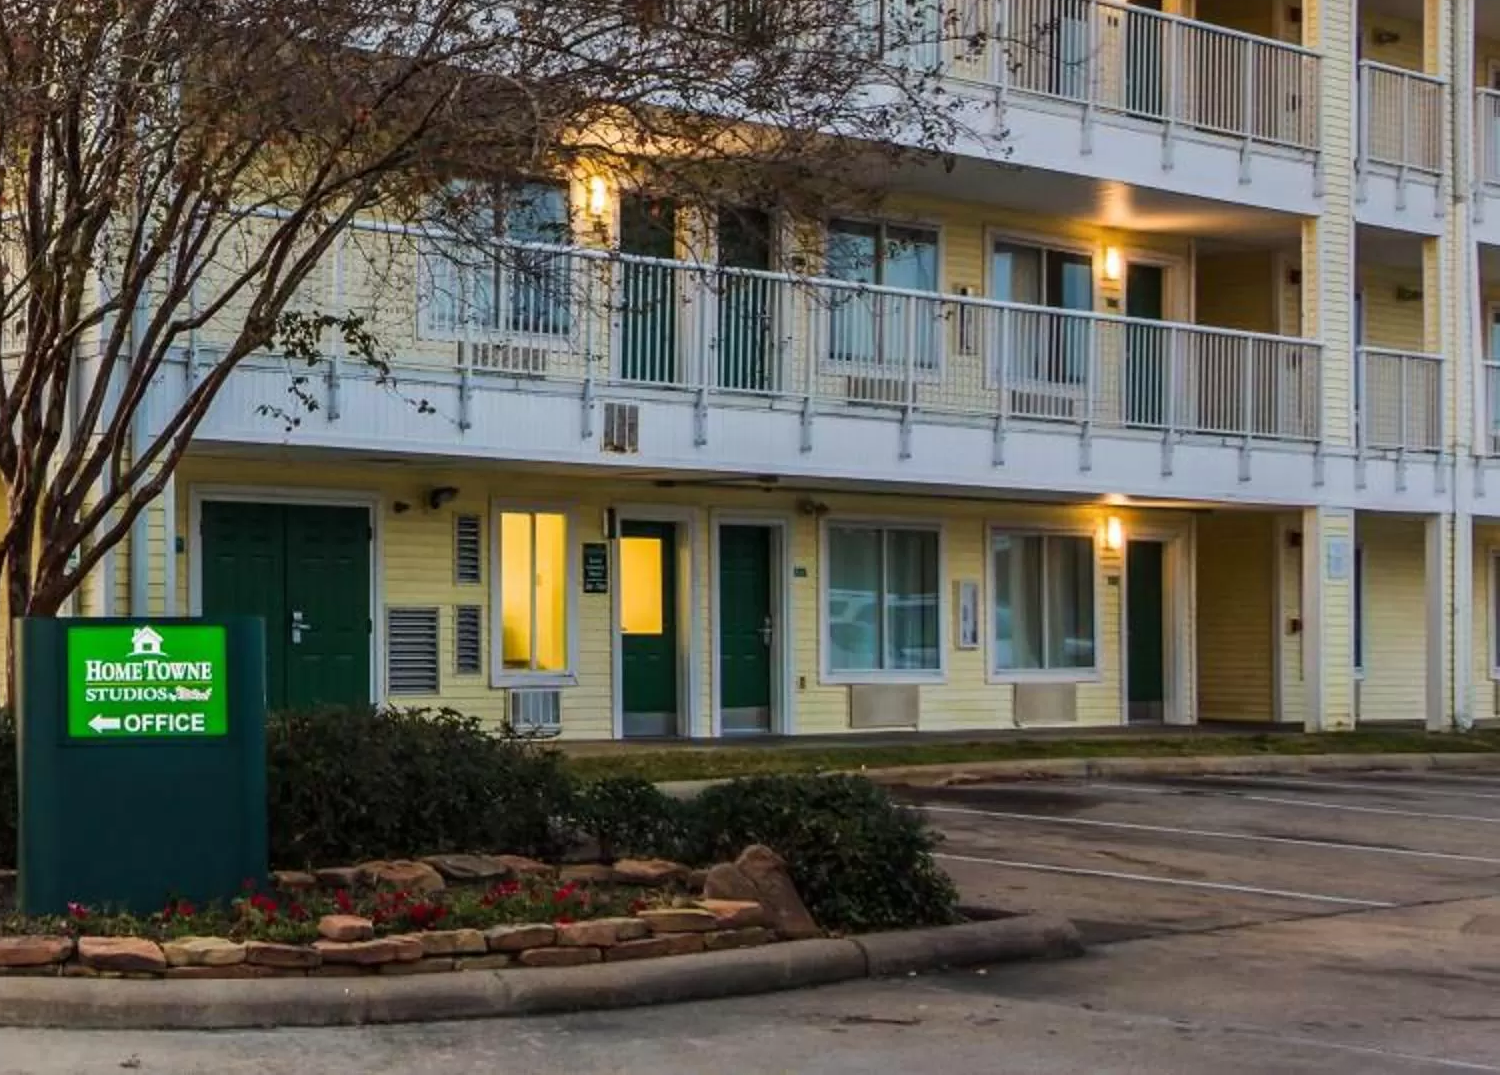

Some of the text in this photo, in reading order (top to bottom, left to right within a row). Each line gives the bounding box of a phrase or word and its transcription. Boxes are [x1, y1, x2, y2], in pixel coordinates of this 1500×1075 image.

[84, 659, 213, 681] HOMETOWNE
[85, 687, 168, 702] STUDIOS
[124, 713, 206, 732] OFFICE
